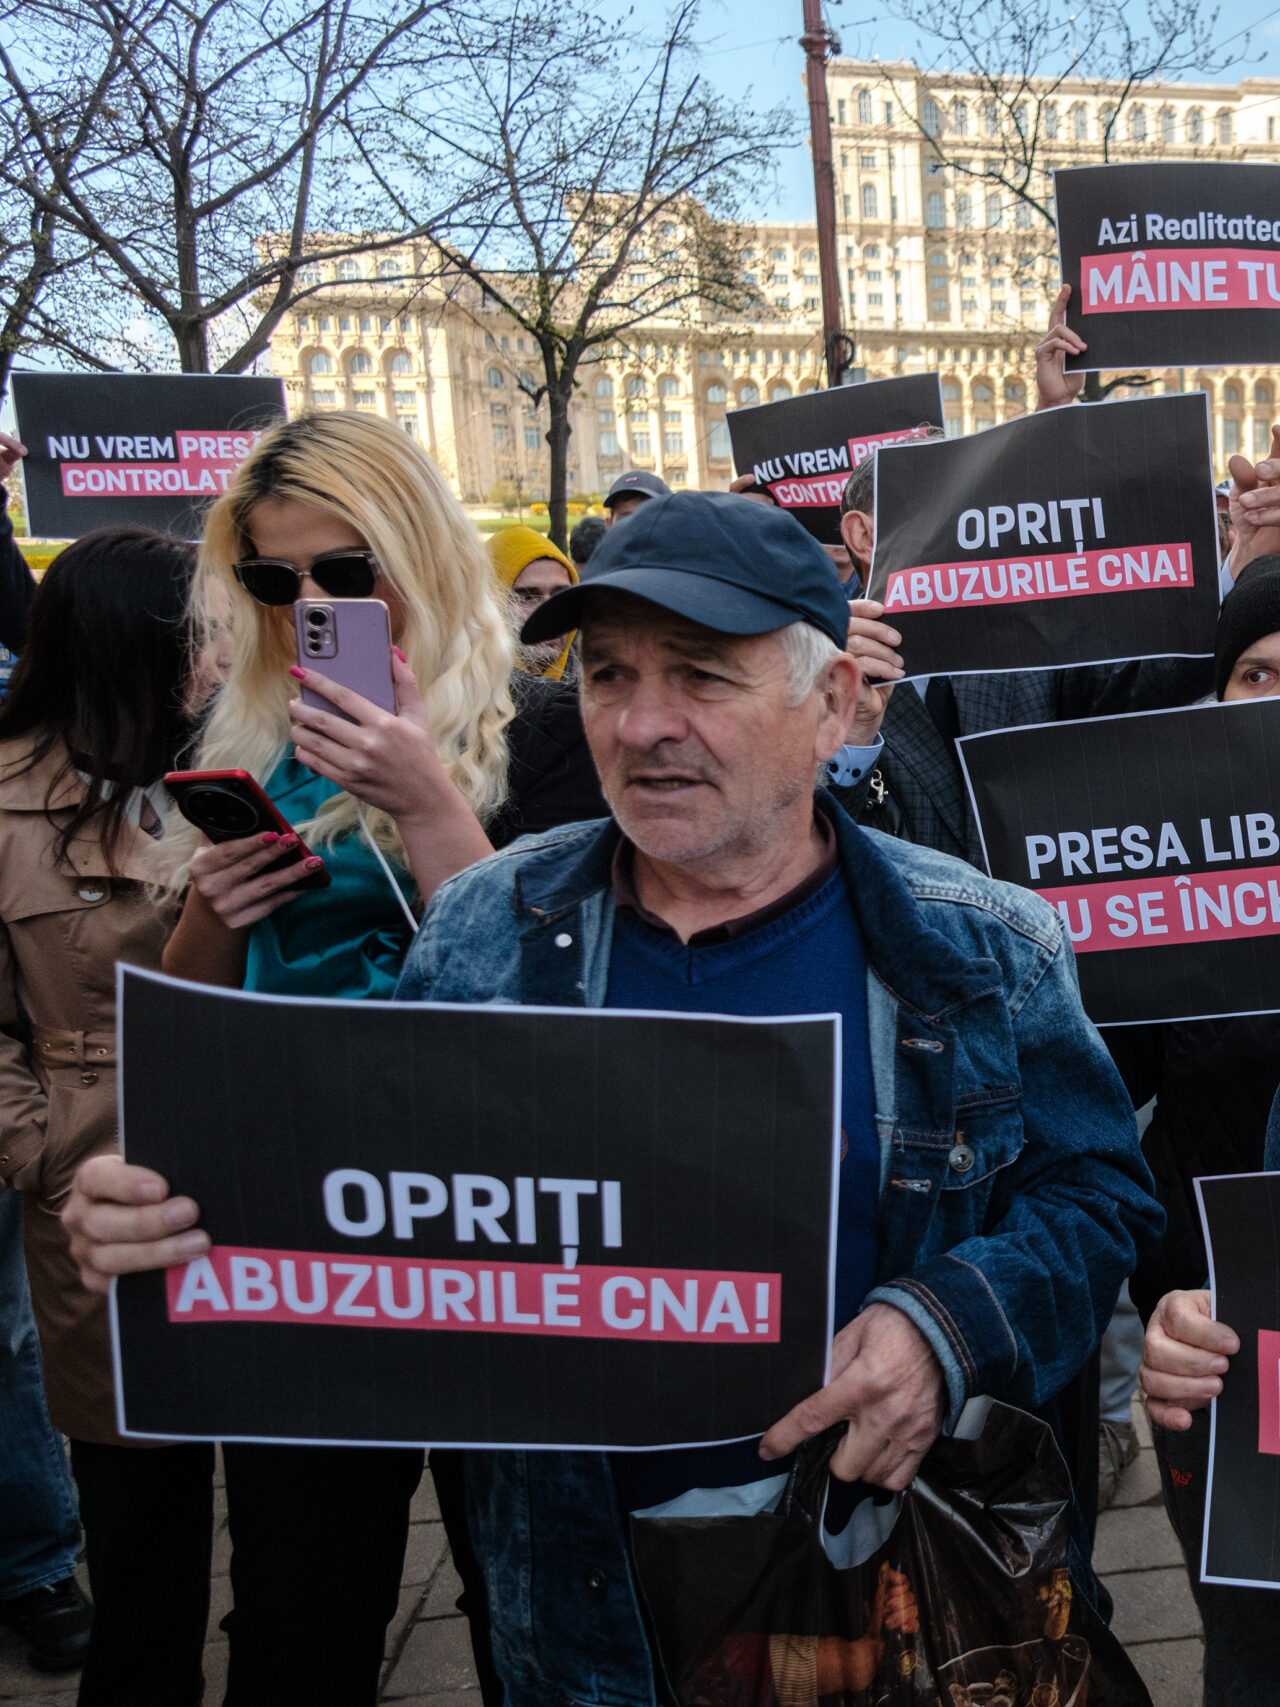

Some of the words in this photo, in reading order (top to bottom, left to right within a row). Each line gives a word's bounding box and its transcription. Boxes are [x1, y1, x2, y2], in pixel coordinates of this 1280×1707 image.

[1098, 214, 1138, 245] Azi
[1090, 251, 1228, 305] MÂINE
[49, 436, 89, 458] NU
[96, 437, 174, 458] VREM
[753, 458, 784, 484] NU
[785, 446, 848, 474] VREM
[66, 464, 240, 492] CONTROLAT
[958, 498, 1105, 555] OPRIȚI
[889, 558, 1089, 607] ABUZURILE
[1098, 549, 1187, 586] CNA!
[1026, 822, 1190, 879] PRESA
[1058, 899, 1092, 941] U
[1106, 891, 1168, 937] SE
[324, 1169, 621, 1270] OPRIȚI
[176, 1257, 580, 1326] ABUZURILE
[602, 1276, 769, 1333] CNA!
